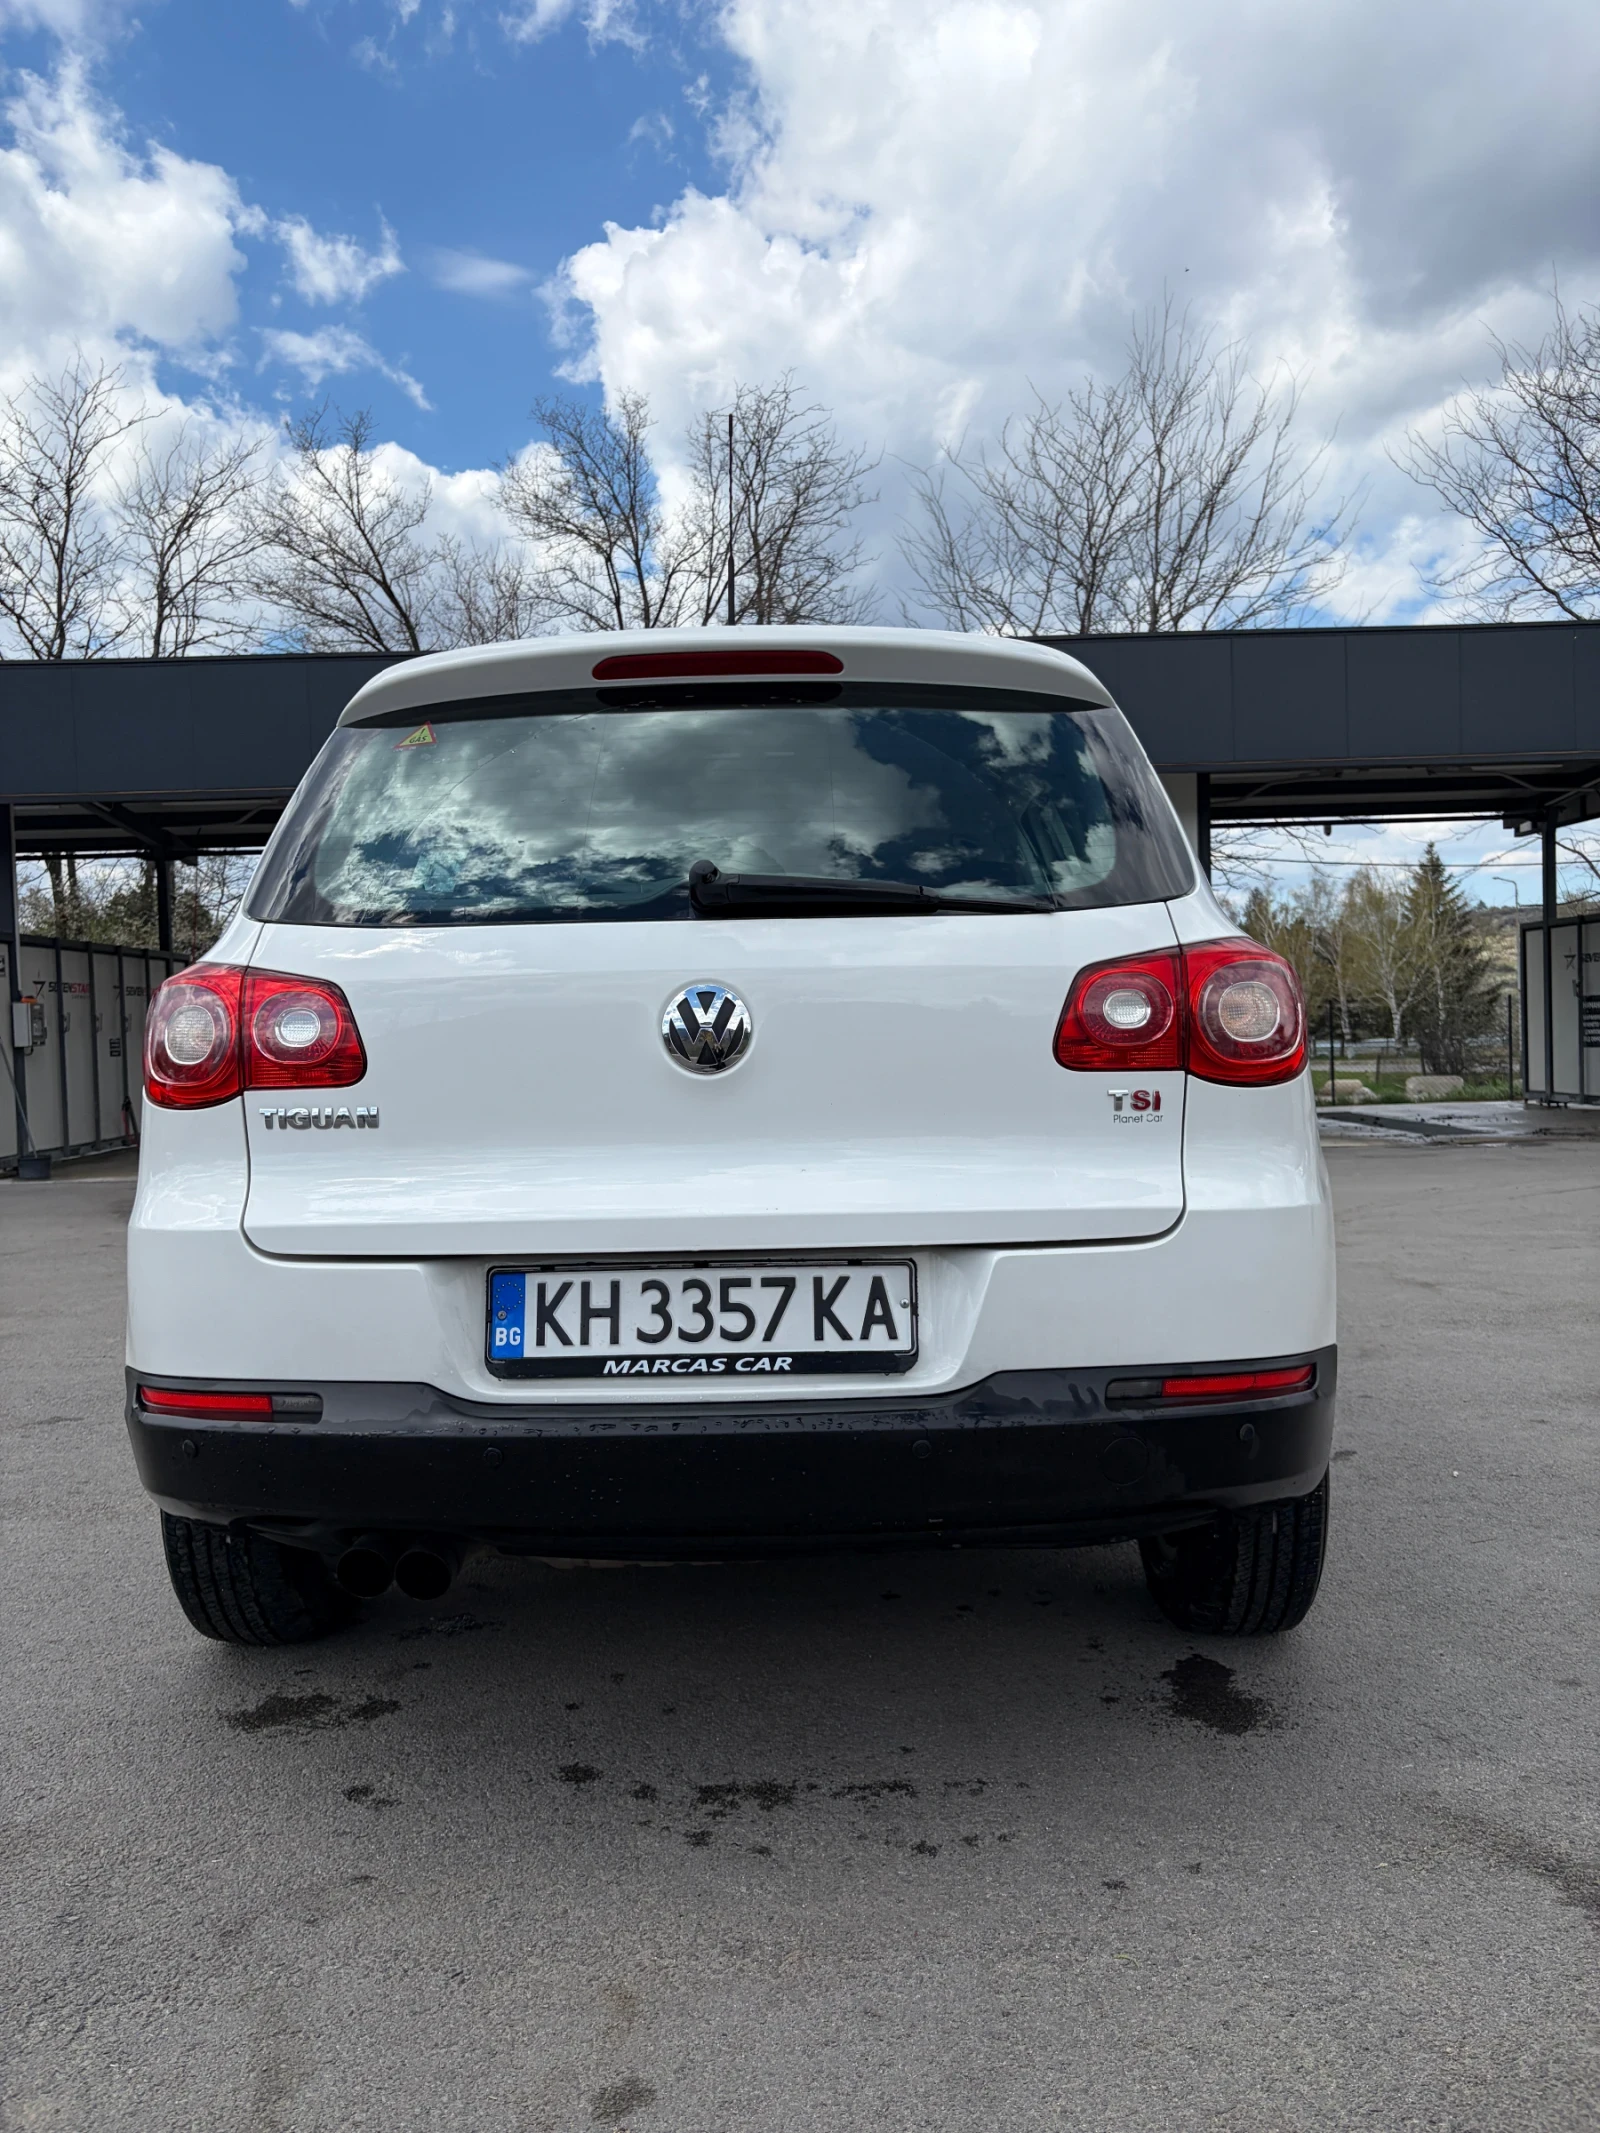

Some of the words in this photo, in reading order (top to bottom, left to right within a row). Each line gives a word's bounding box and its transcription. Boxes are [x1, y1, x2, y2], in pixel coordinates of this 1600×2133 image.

[408, 735, 428, 744] GAS
[1107, 1089, 1161, 1112] TSI
[259, 1106, 379, 1130] TIGUAN
[1113, 1114, 1143, 1123] Planet
[1146, 1113, 1163, 1122] Car
[495, 1327, 521, 1346] BG
[603, 1358, 728, 1374] MARCAS
[735, 1357, 792, 1371] CAR
